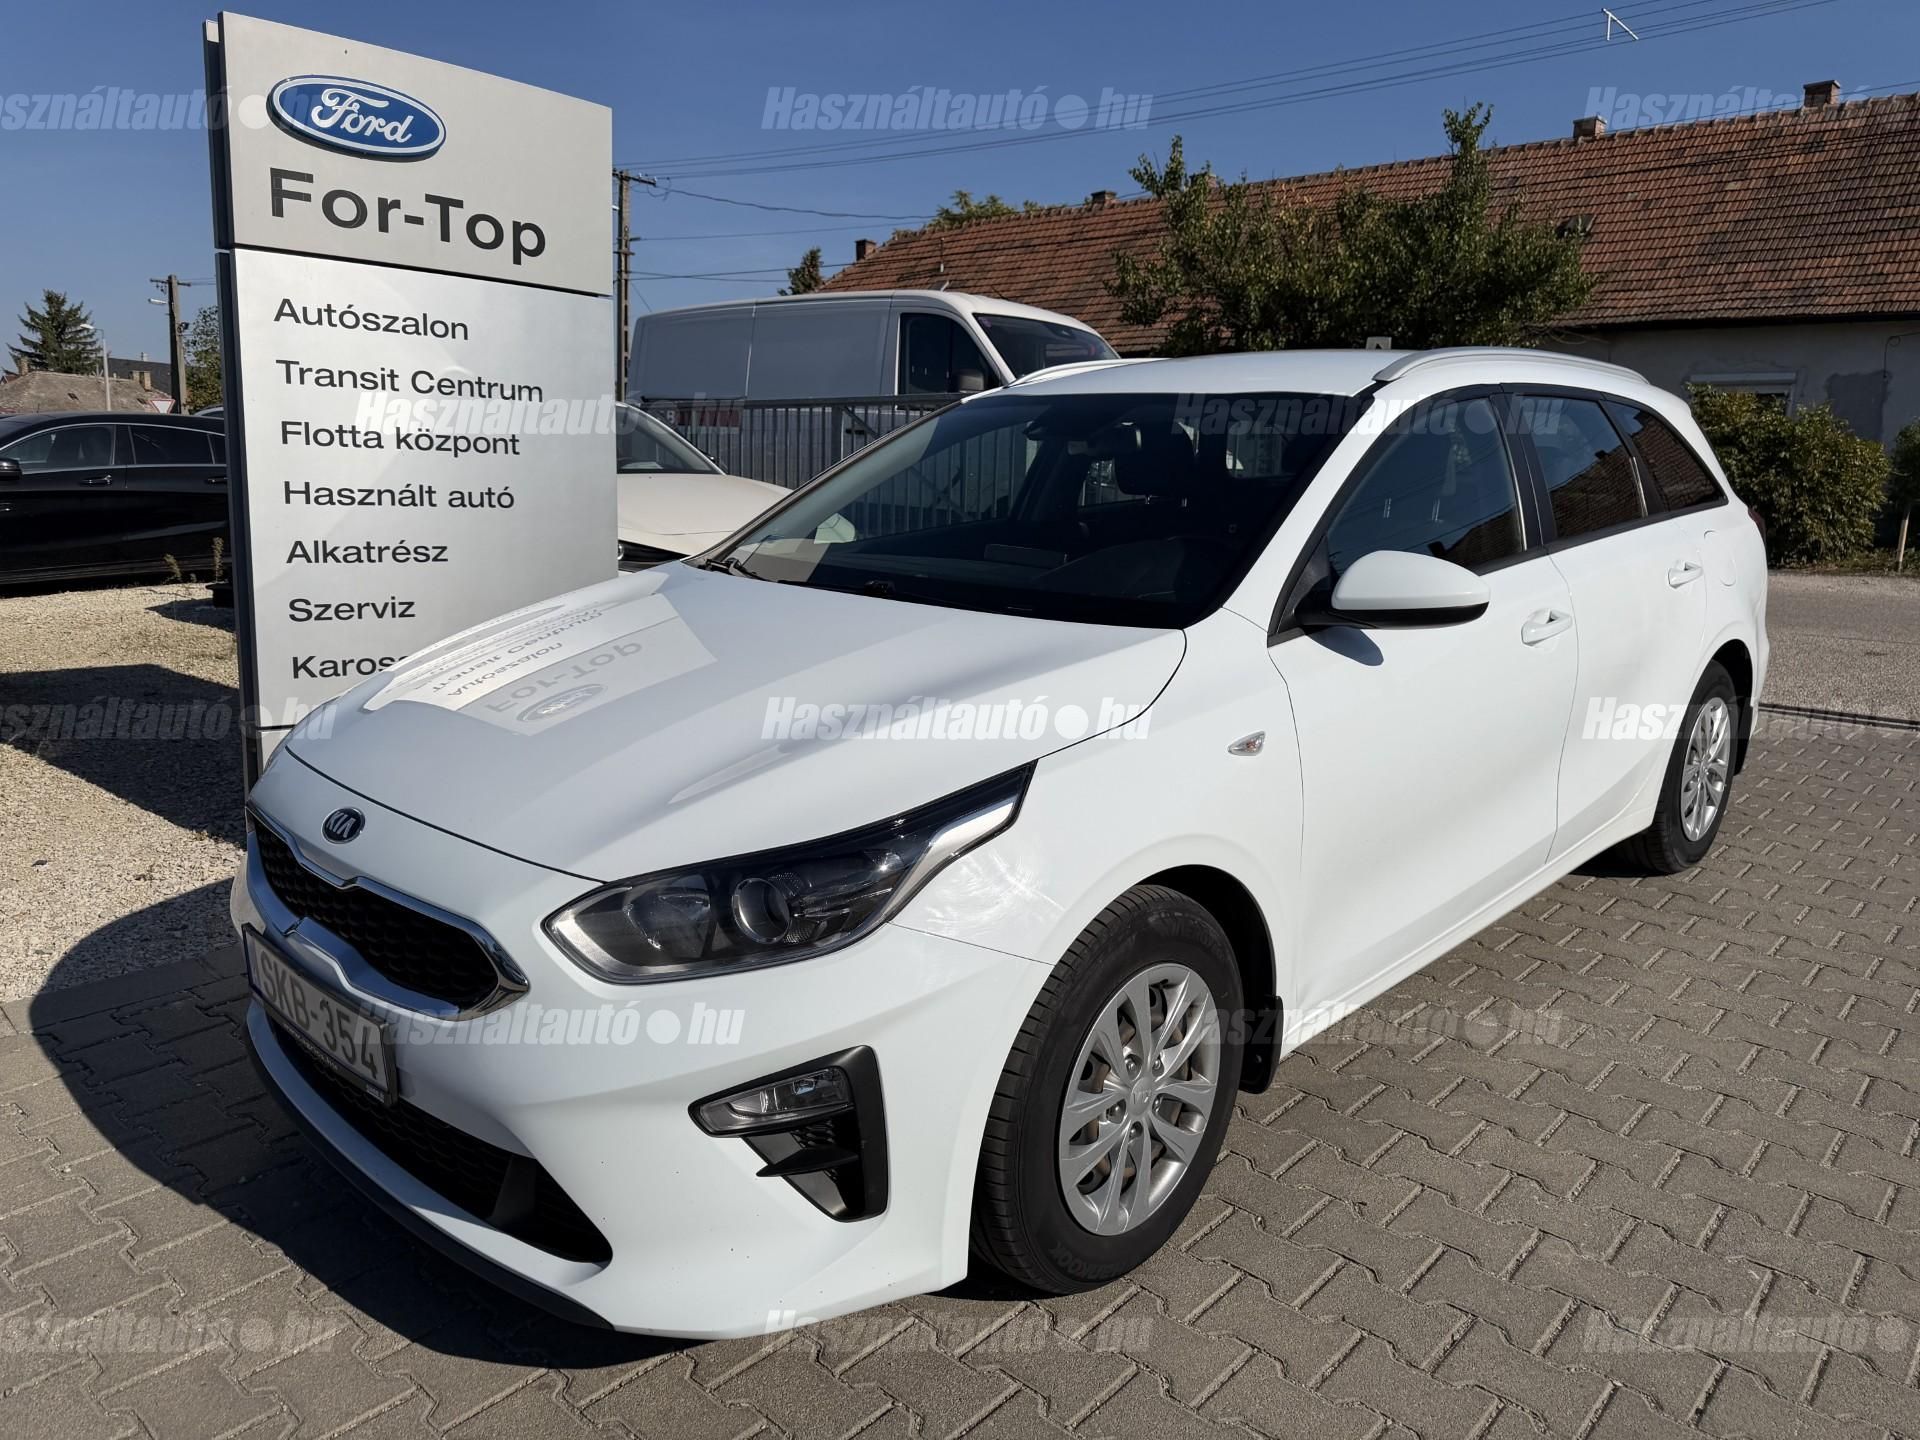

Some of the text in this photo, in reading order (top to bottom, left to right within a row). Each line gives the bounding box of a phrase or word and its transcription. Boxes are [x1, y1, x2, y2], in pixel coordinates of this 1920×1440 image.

[311, 88, 414, 143] Ford
[270, 167, 546, 266] For-Top
[274, 298, 468, 341] Autószalon
[276, 359, 543, 403] Transit Centrum
[282, 420, 521, 458] Flotta központ
[284, 480, 515, 509] Használt autó
[287, 539, 449, 564] Alkatrész
[288, 595, 416, 623] Szerviz
[292, 655, 409, 679] Karos
[326, 811, 357, 838] KIA
[260, 950, 378, 1079] SKB-354
